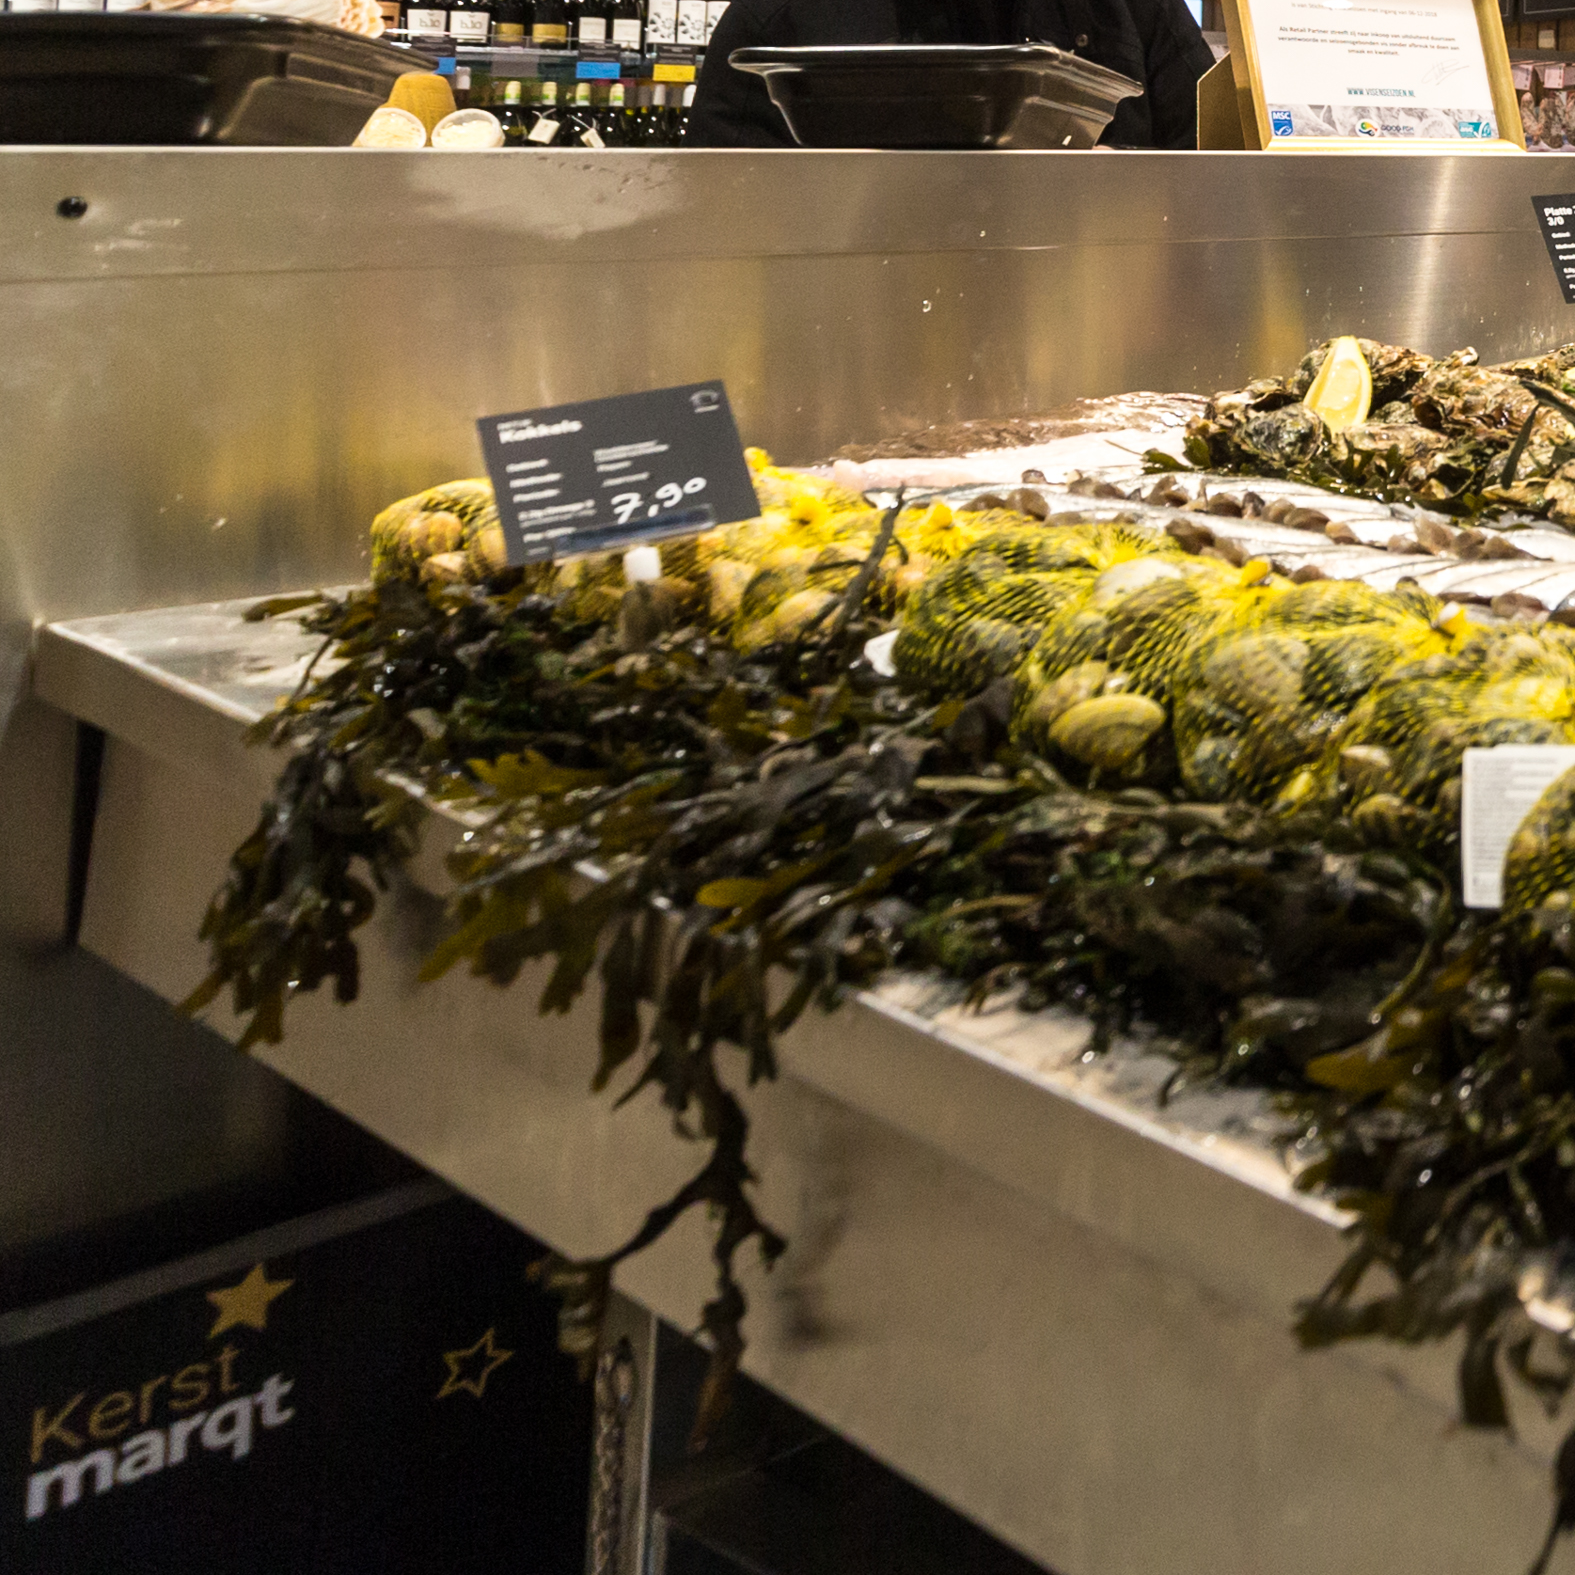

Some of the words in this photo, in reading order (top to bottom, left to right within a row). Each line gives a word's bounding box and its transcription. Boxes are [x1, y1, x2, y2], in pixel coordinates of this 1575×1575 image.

[1272, 111, 1291, 121] MSC
[1544, 205, 1573, 217] Platte
[1547, 216, 1565, 227] 3/0
[609, 476, 707, 525] 7,90
[29, 1342, 241, 1465] Kerst
[25, 1371, 297, 1522] marqt
